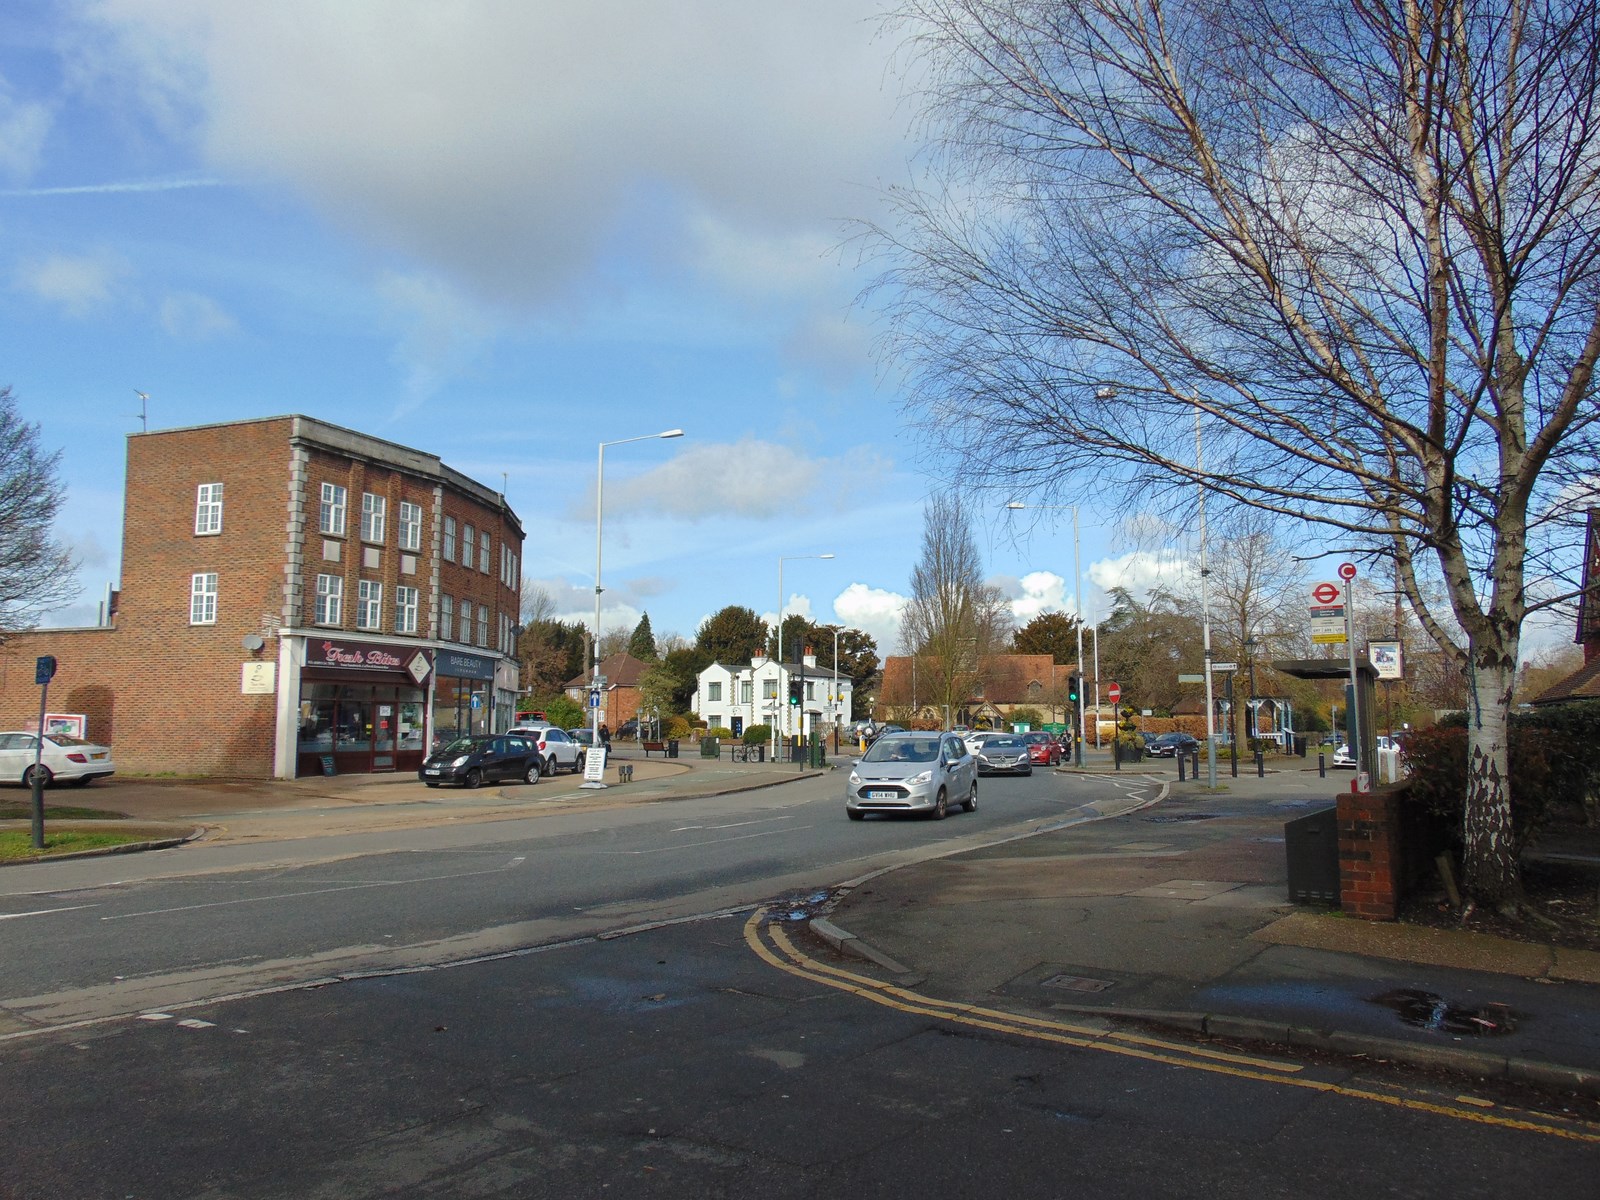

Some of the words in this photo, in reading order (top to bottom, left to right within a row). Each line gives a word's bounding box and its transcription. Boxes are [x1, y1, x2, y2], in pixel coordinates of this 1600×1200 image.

[1341, 565, 1354, 578] C
[326, 648, 364, 664] Fresh
[366, 651, 401, 666] Bites
[450, 656, 464, 666] BARE
[463, 658, 481, 669] BEAUTY
